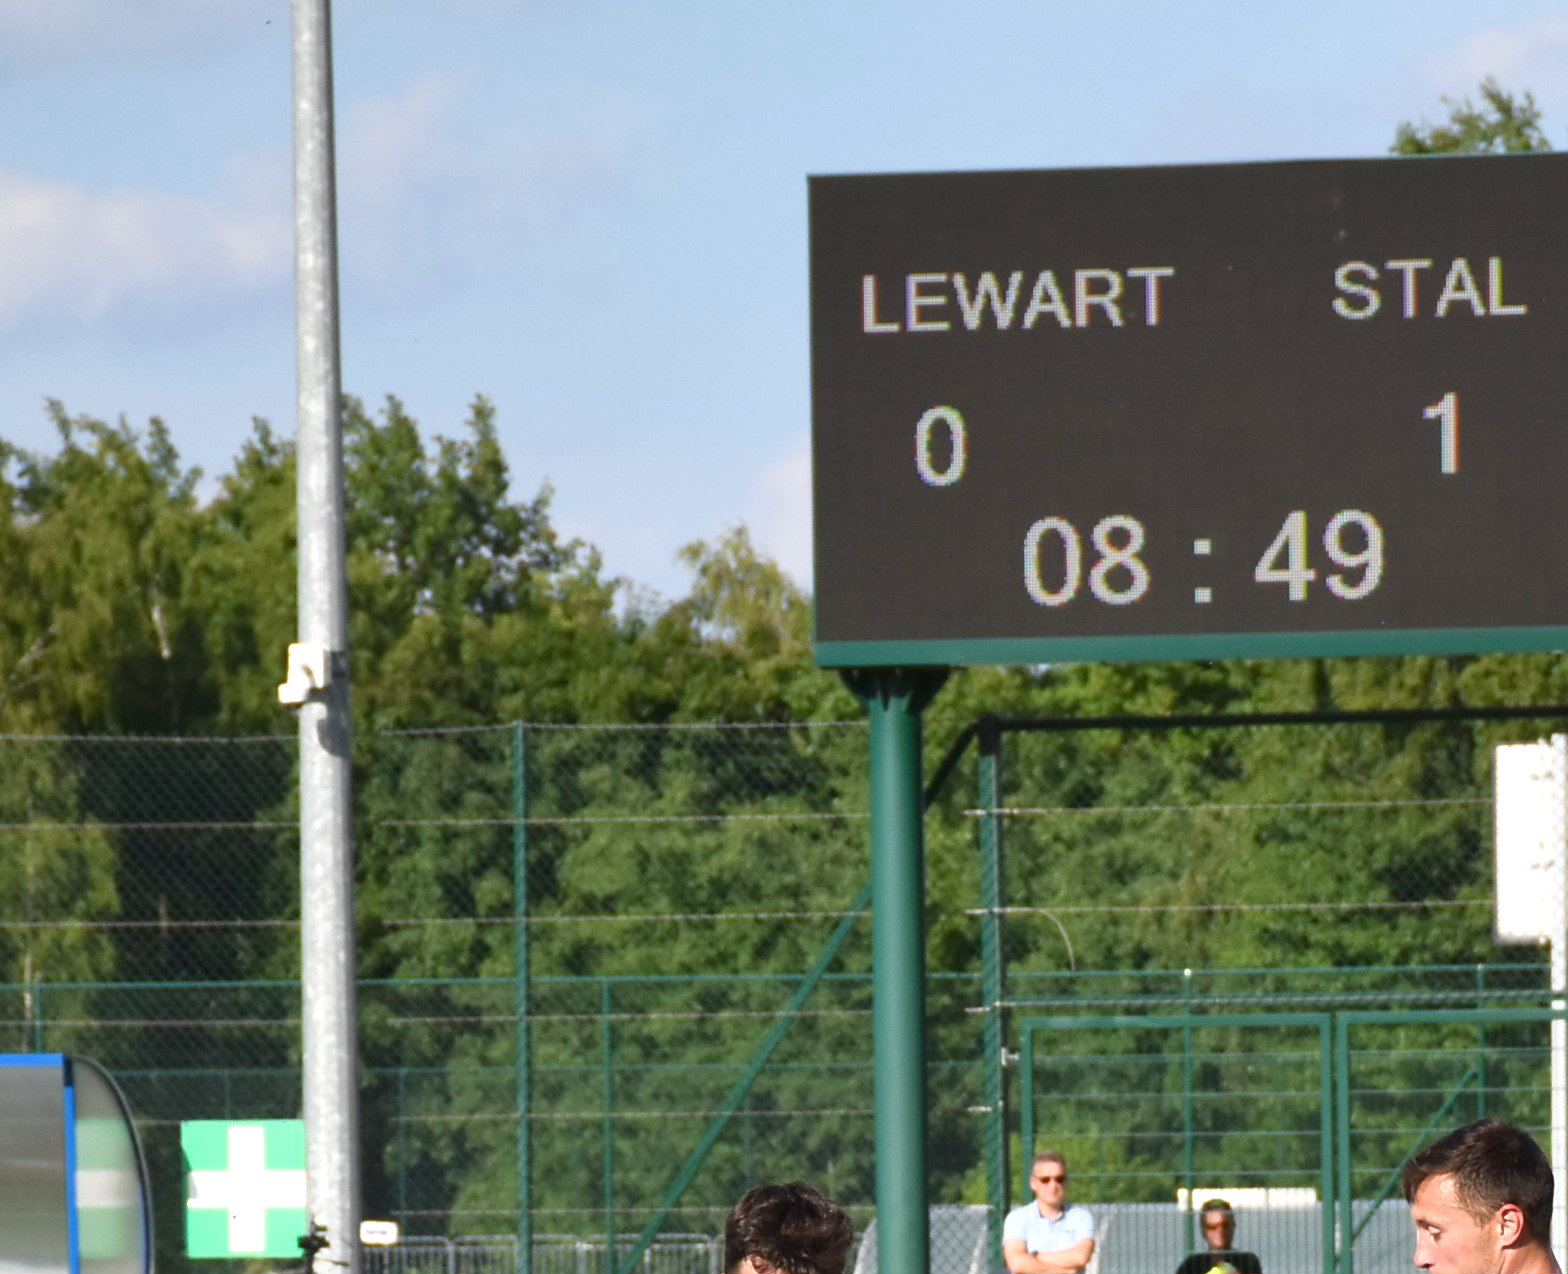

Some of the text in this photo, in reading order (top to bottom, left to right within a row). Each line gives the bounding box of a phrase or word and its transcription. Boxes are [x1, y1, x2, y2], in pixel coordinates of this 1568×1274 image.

[863, 256, 1528, 332] LEWART STAL
[913, 391, 1460, 487] 0 1
[1022, 514, 1152, 607] 08
[1254, 508, 1385, 602] 49
